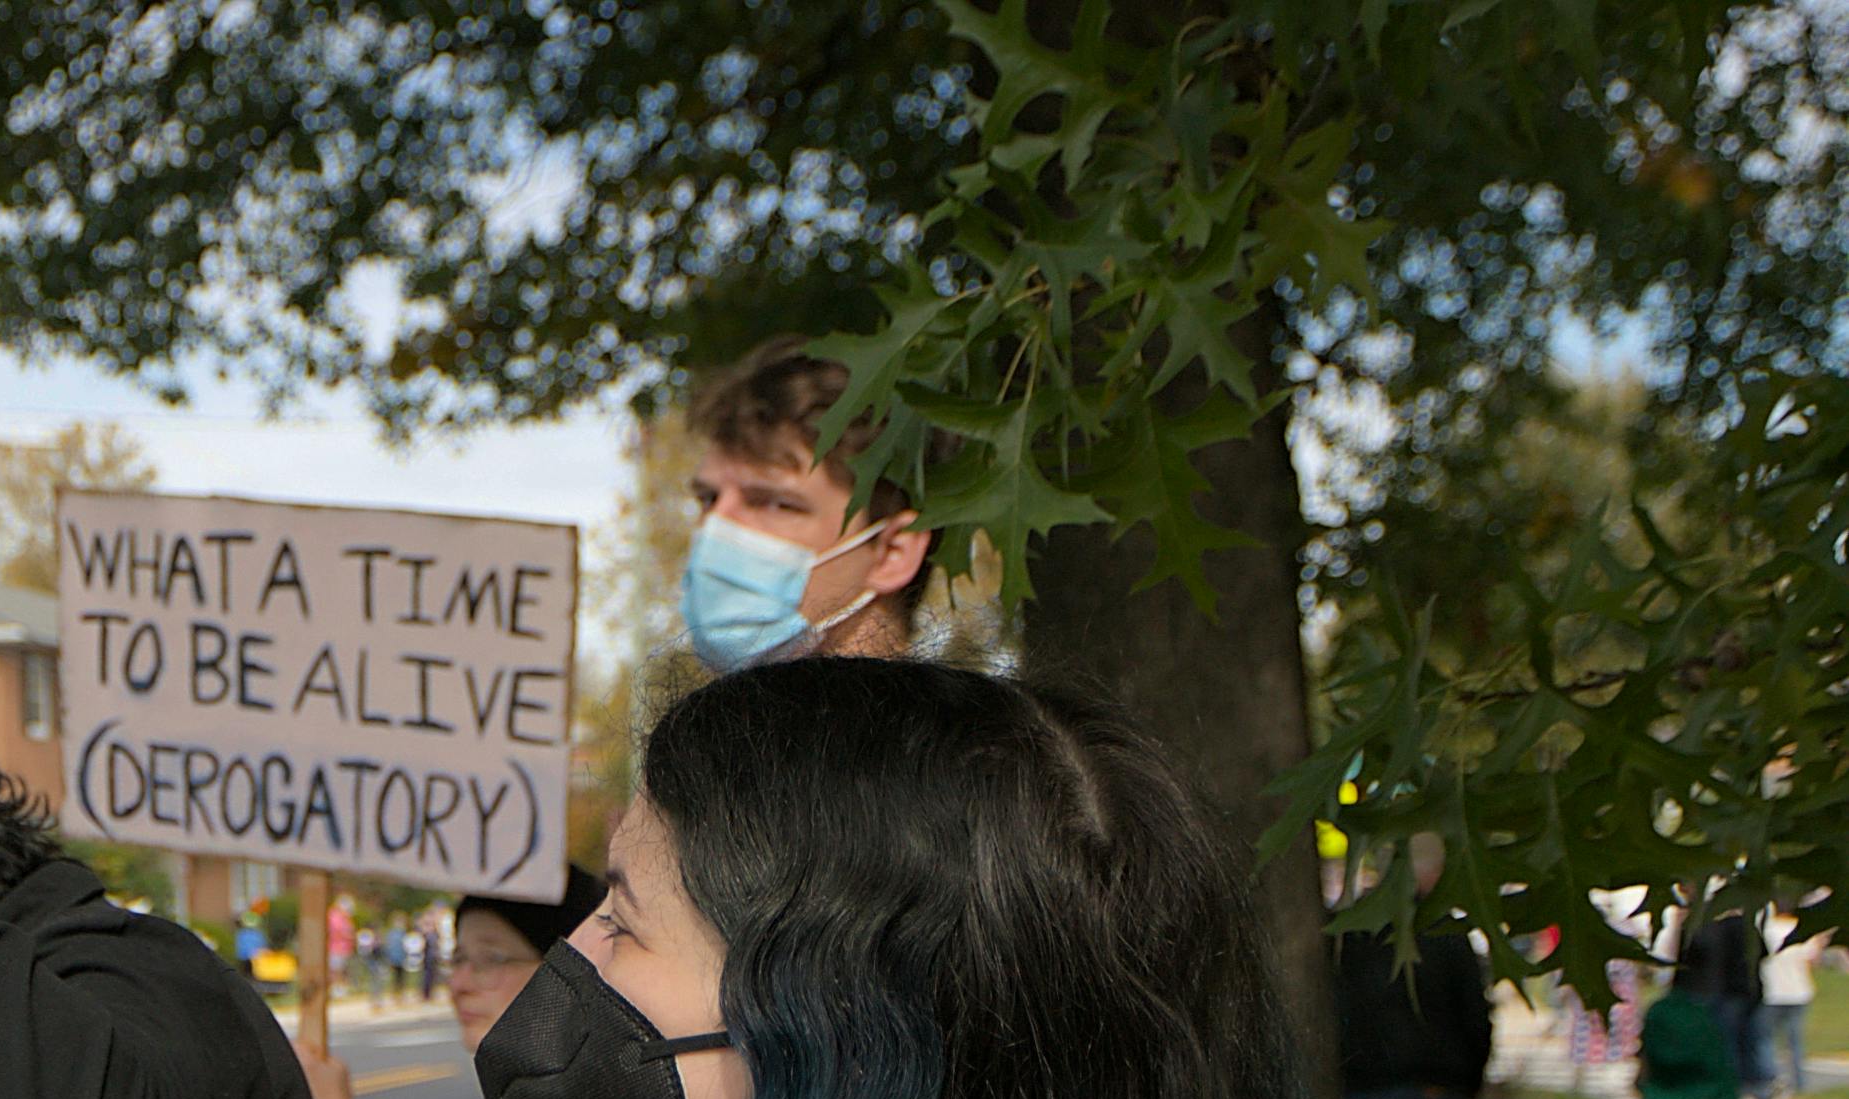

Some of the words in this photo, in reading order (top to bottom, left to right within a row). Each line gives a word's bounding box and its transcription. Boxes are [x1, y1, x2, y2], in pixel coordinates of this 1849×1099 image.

[66, 521, 255, 612] WHAT
[257, 537, 310, 619] A
[342, 547, 552, 640] TIME
[79, 612, 165, 694] TO
[188, 620, 277, 711] BE
[291, 642, 563, 746] ALIVE
[77, 718, 542, 888] (DEROGATORY)
